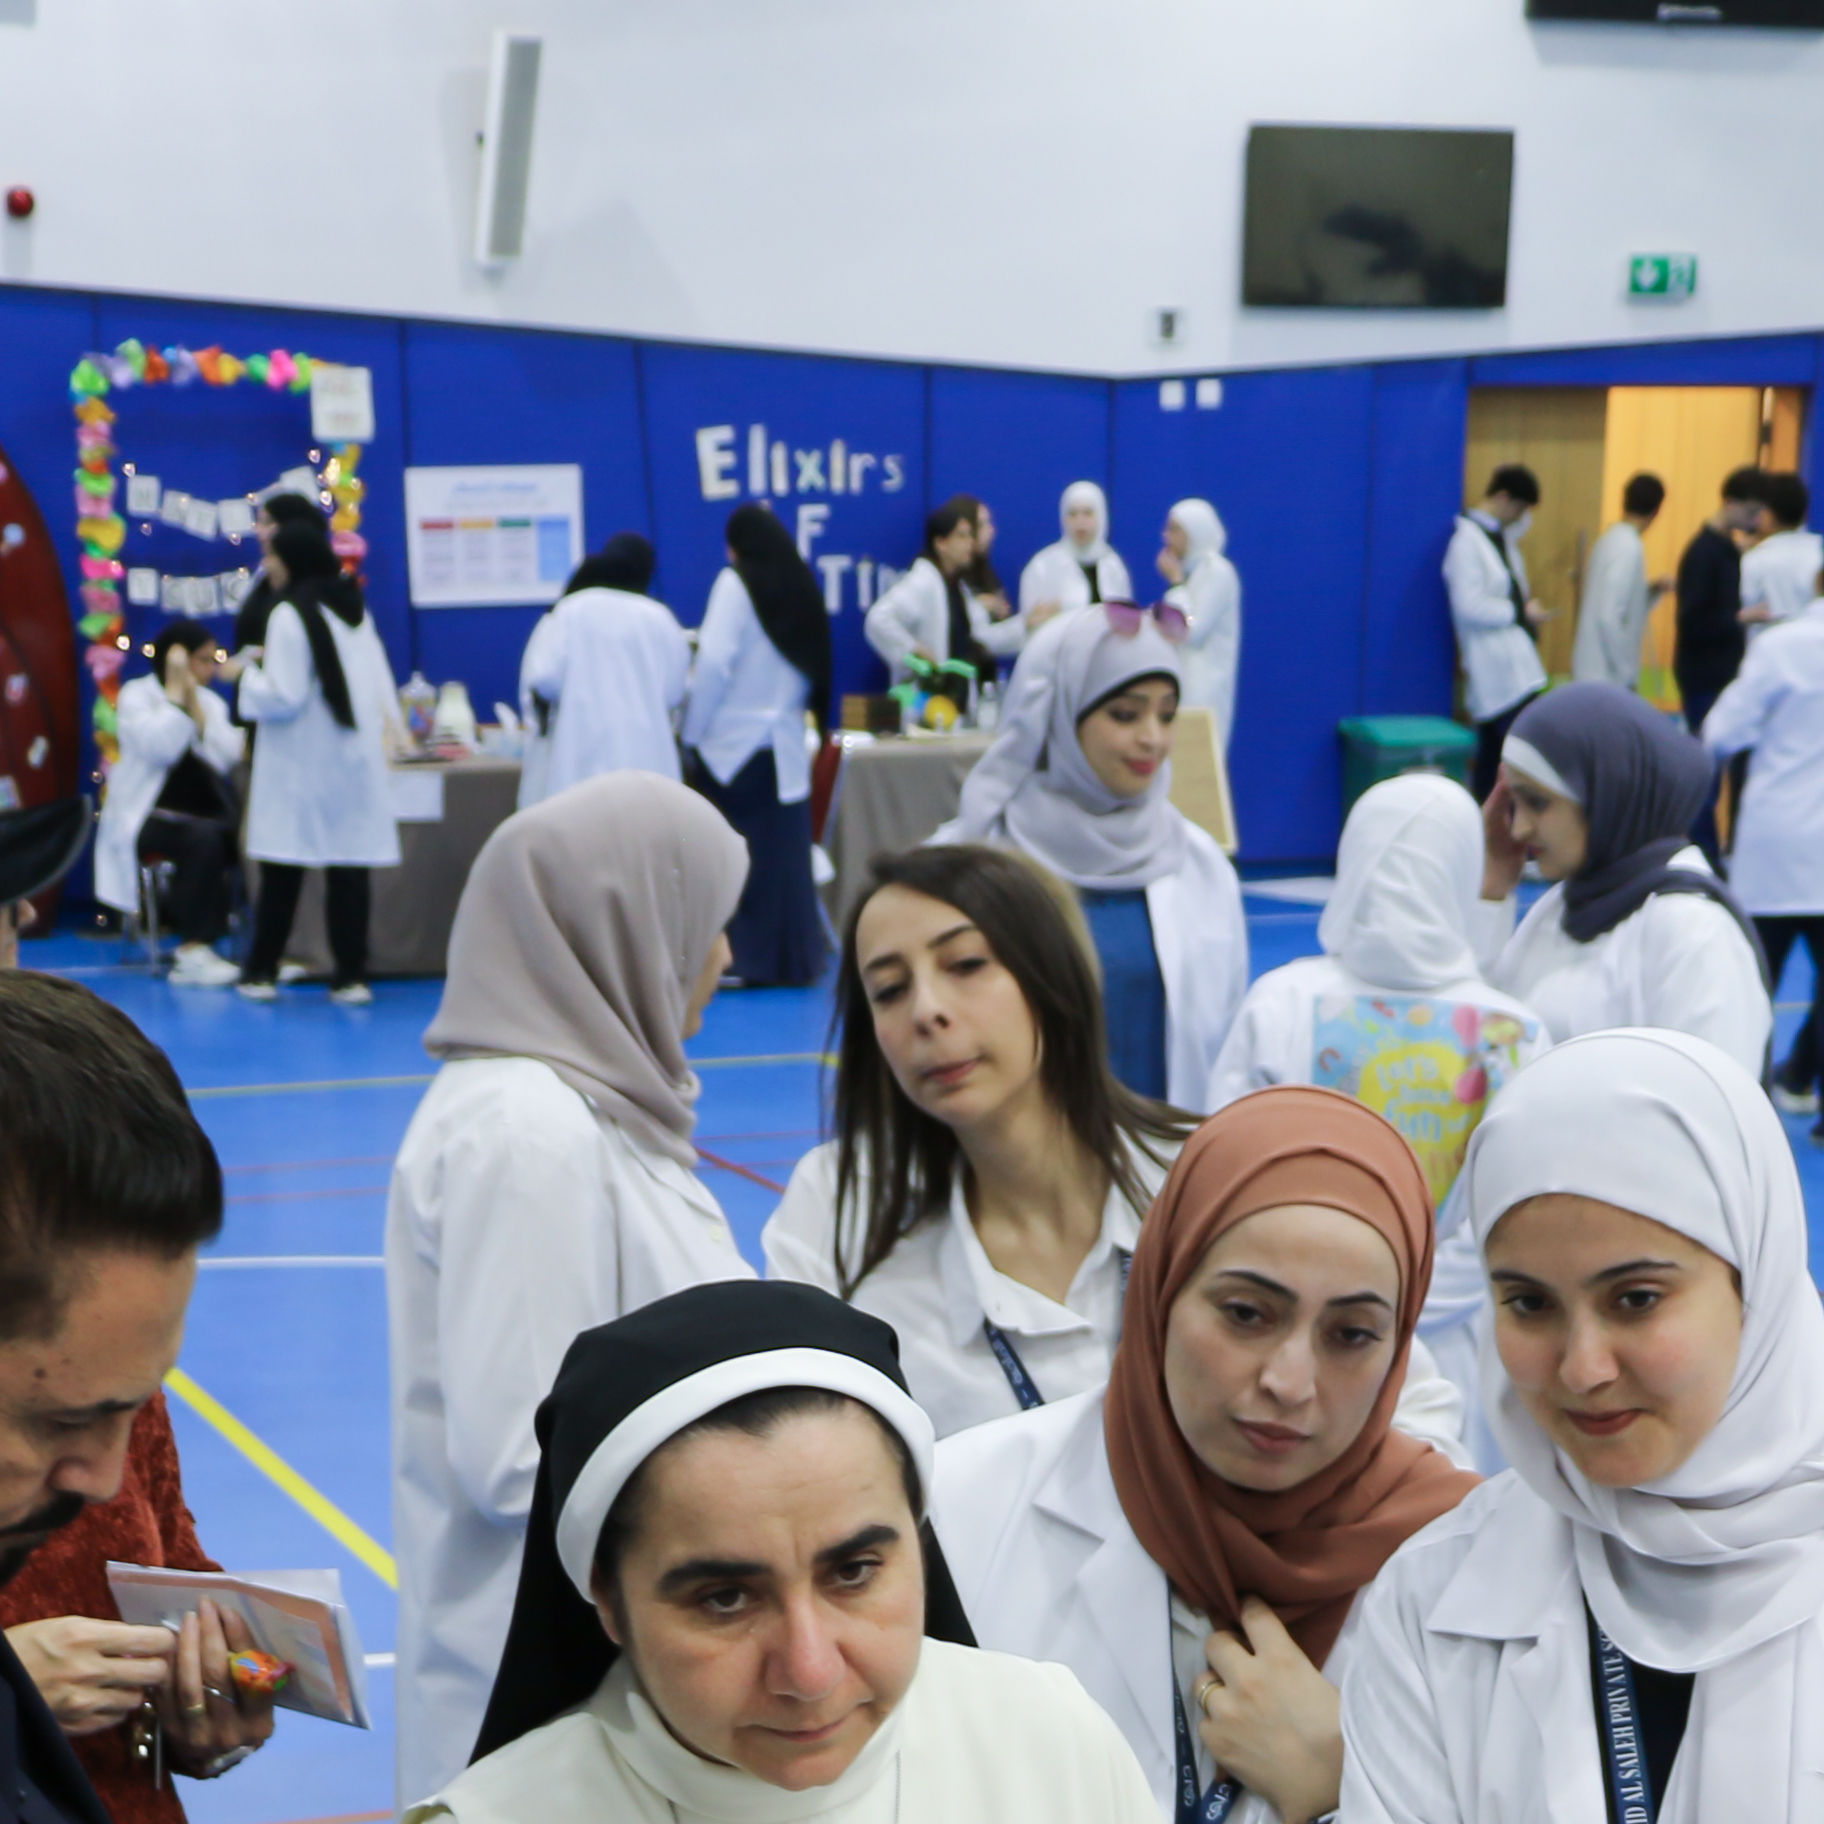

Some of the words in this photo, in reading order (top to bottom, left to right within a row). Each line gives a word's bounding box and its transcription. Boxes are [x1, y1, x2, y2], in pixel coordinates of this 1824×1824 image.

[1602, 1652, 1632, 1724] PRIVATE
[1612, 1726, 1641, 1779] SALEH
[1620, 1781, 1646, 1803] AL
